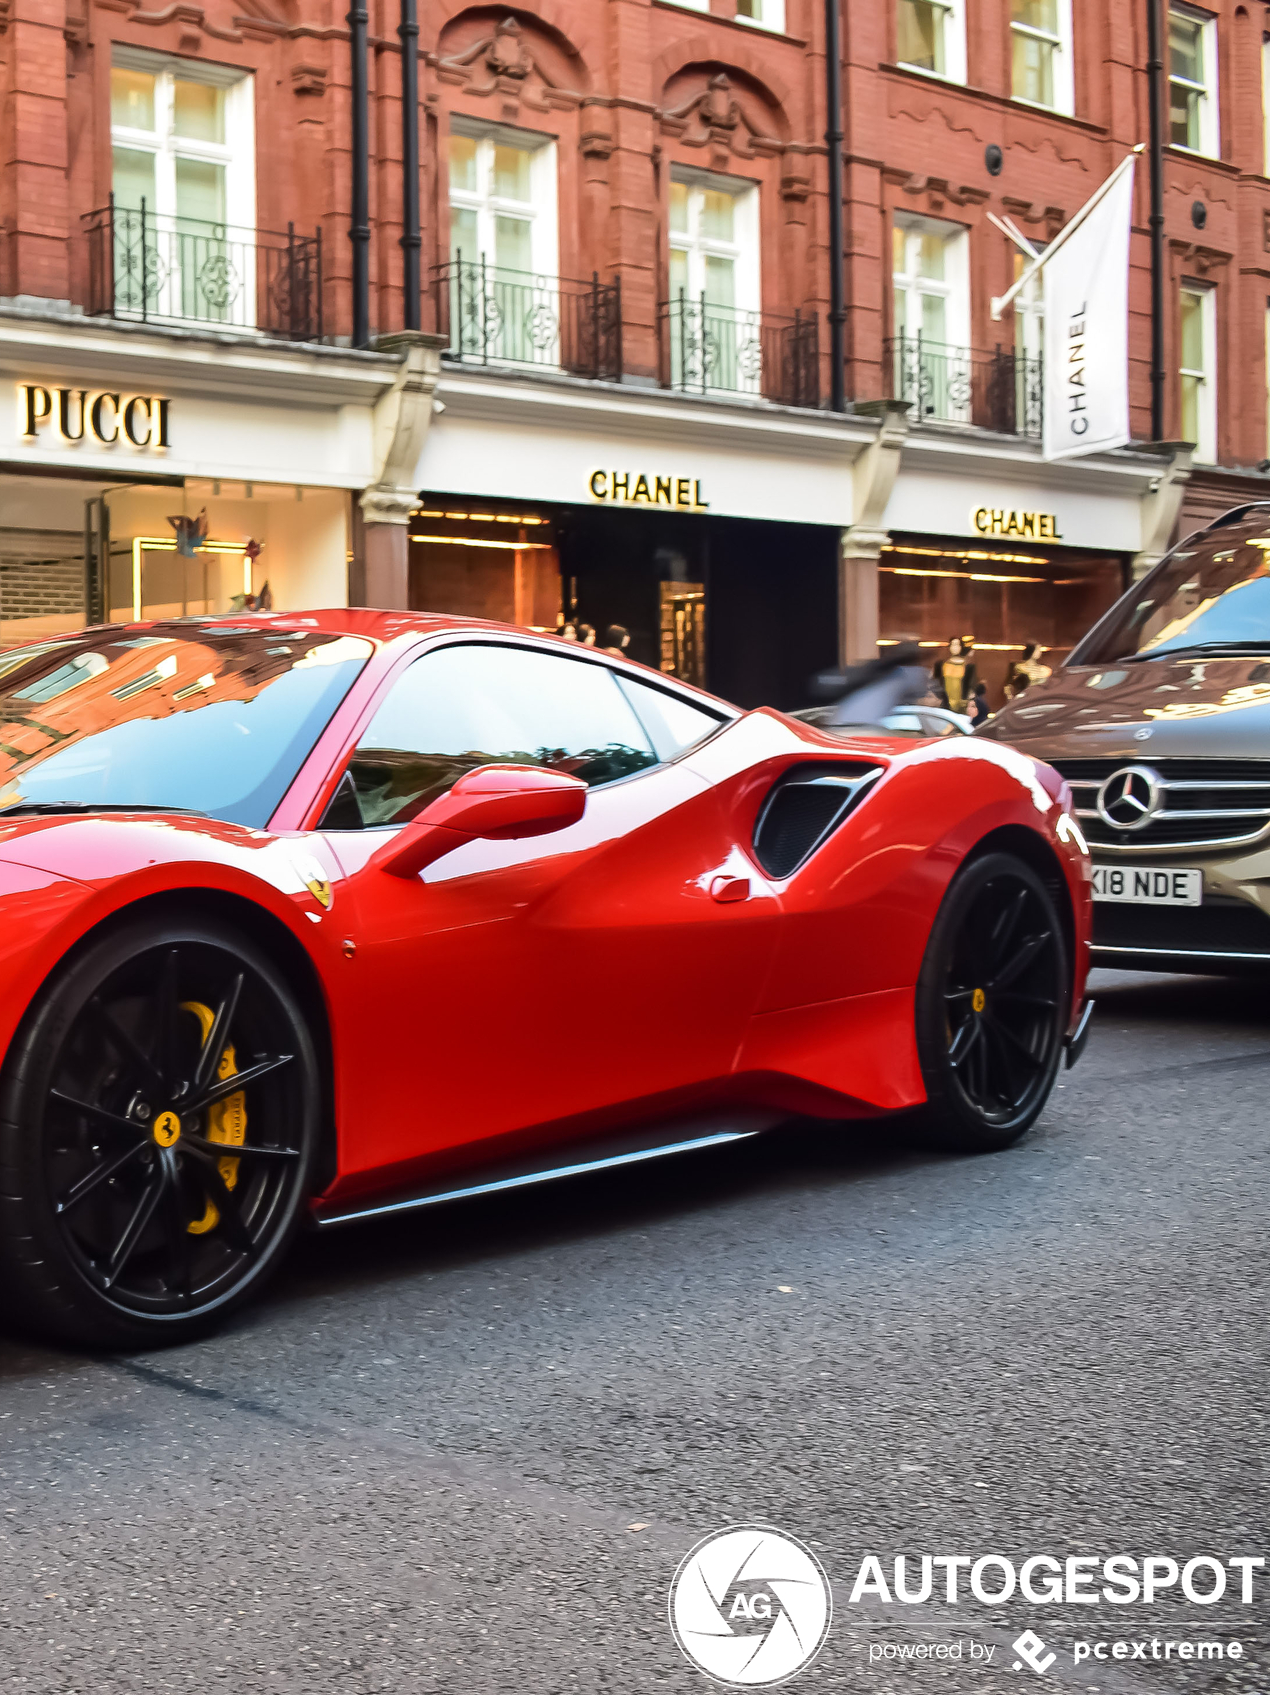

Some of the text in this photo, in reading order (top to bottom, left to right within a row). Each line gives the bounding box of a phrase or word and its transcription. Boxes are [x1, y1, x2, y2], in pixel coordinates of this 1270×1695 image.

[1068, 300, 1089, 436] CHANEL
[20, 384, 173, 448] PUCCI
[589, 469, 710, 508] CHANEL
[974, 507, 1064, 539] CHANEL
[1134, 871, 1189, 899] NDE
